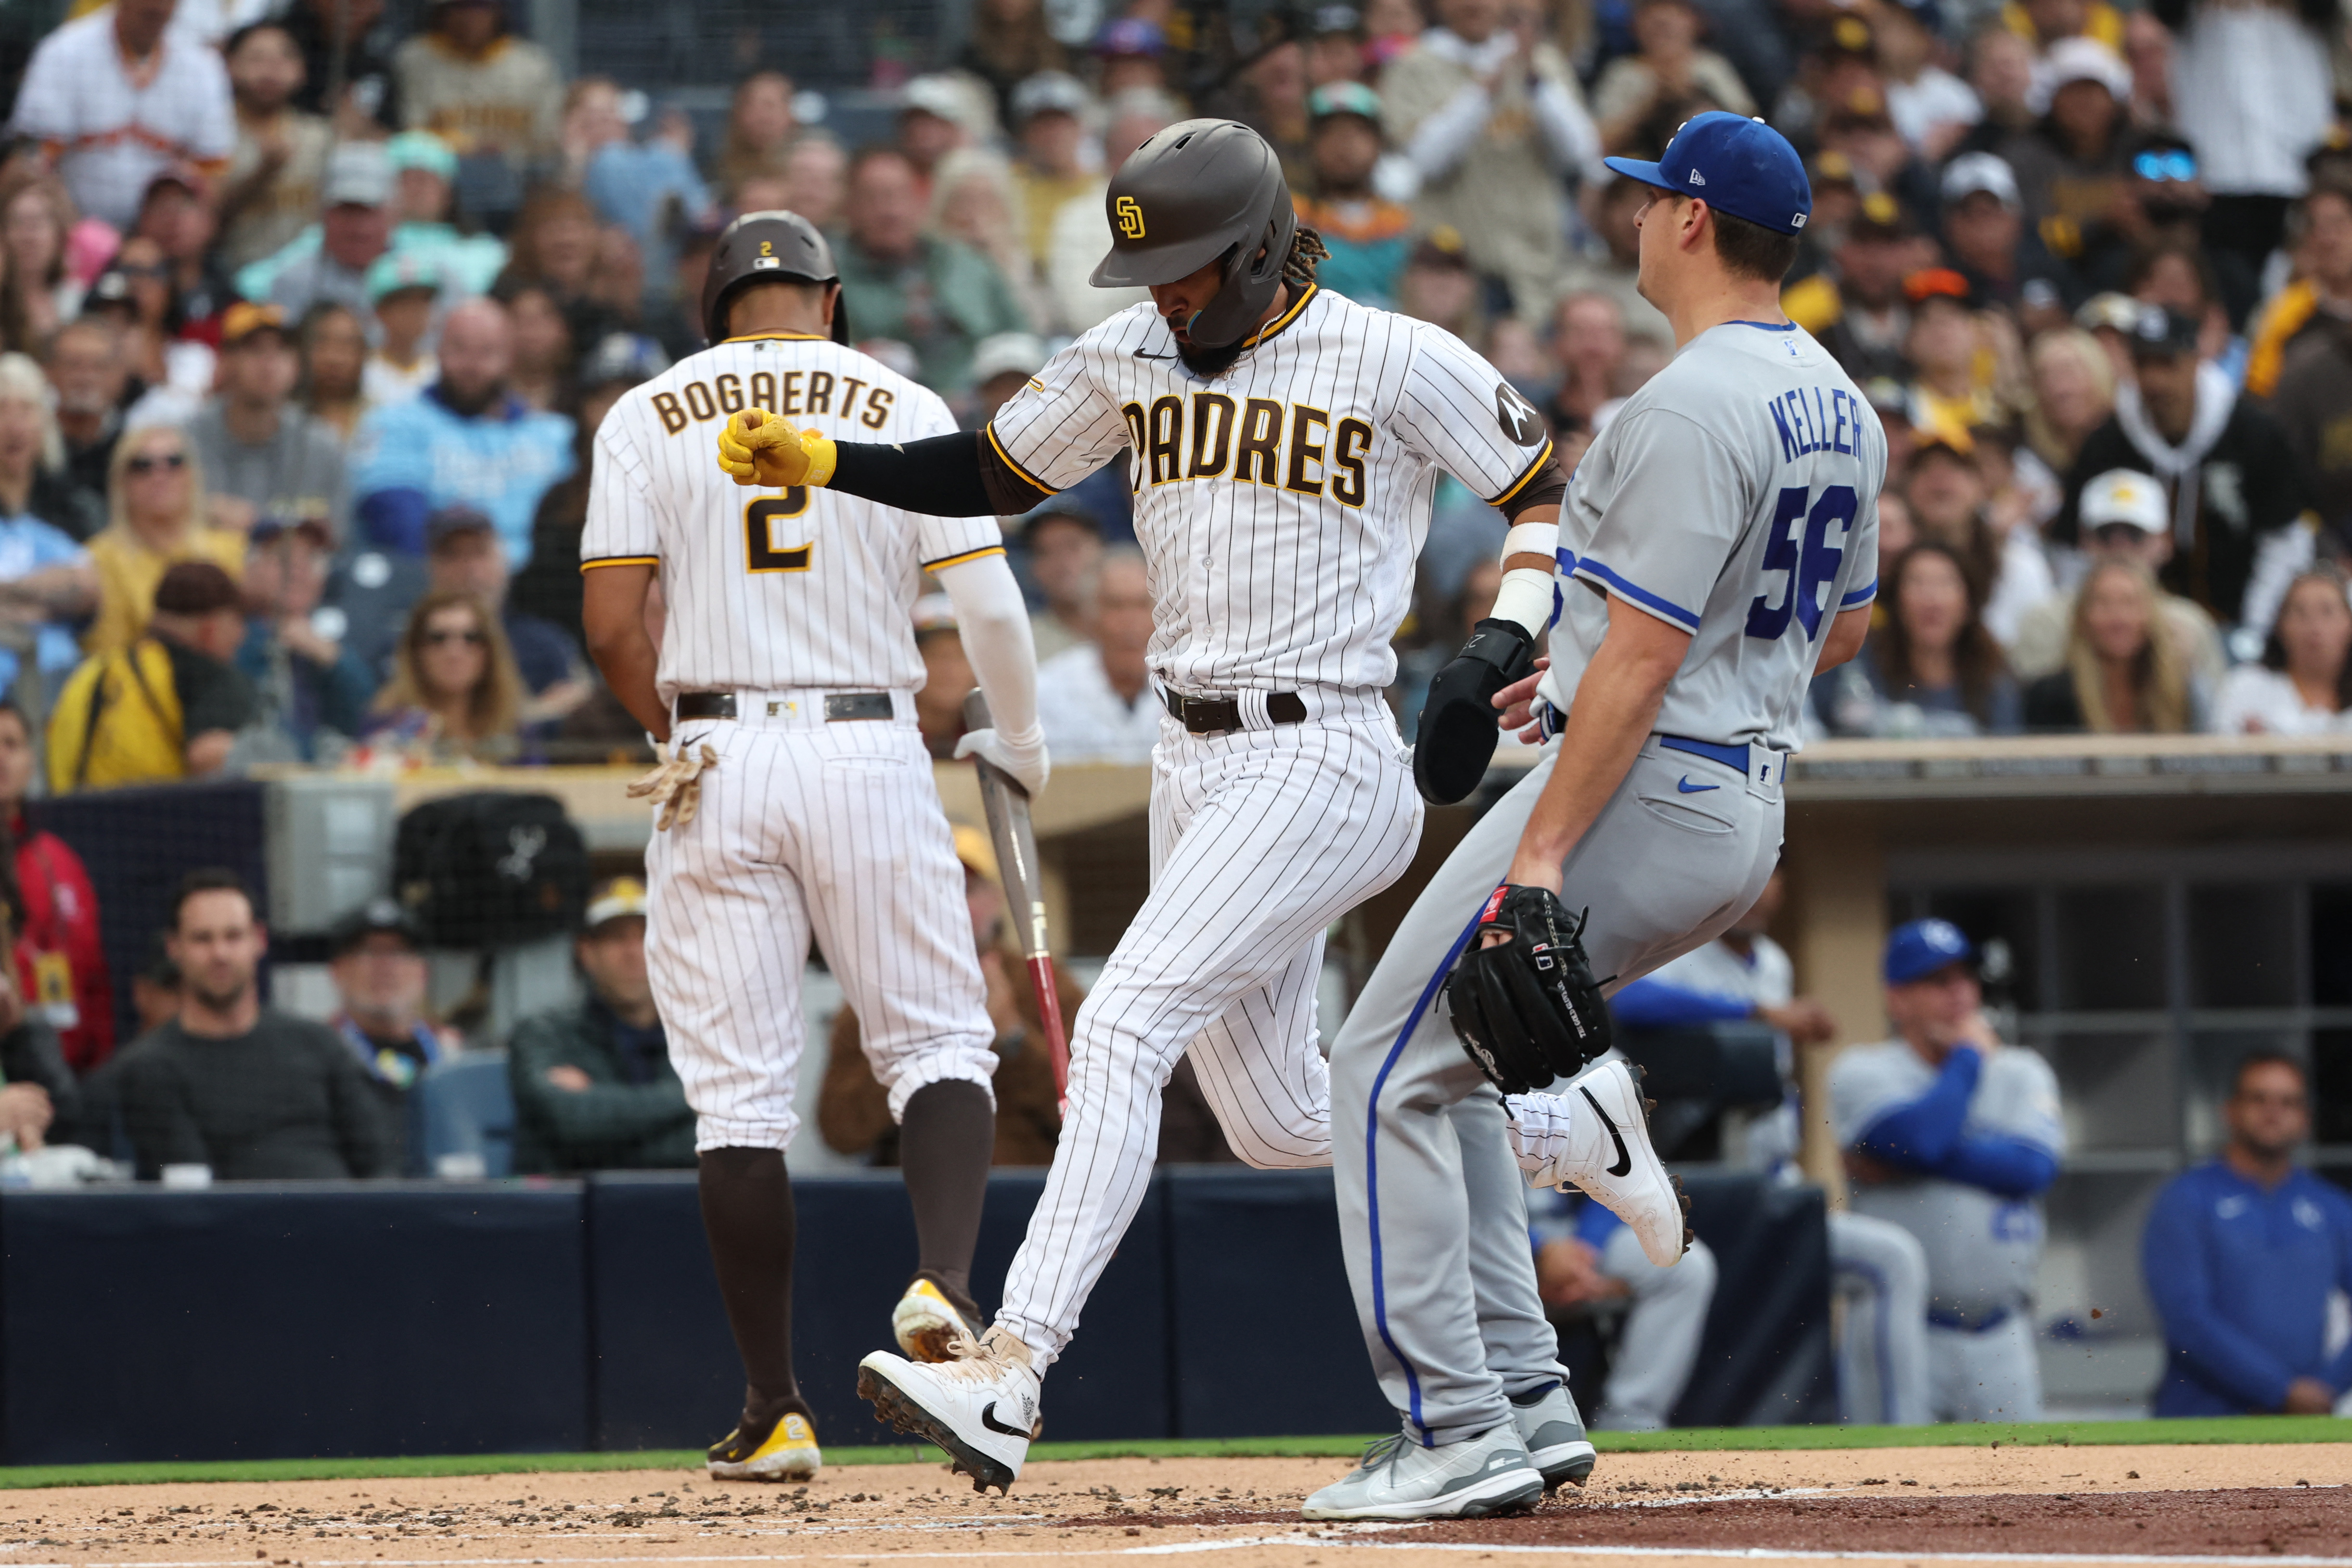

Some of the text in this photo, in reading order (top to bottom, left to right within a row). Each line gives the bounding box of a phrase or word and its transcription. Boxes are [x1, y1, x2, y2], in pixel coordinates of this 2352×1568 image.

[1117, 196, 1145, 239] SD
[760, 241, 772, 257] 2
[651, 371, 894, 437] BOGAERTS
[1769, 386, 1861, 464] KELLER
[744, 486, 813, 574] 2
[1745, 485, 1858, 643] 56
[1569, 1009, 1581, 1026] GOLD
[786, 1415, 805, 1439] 2
